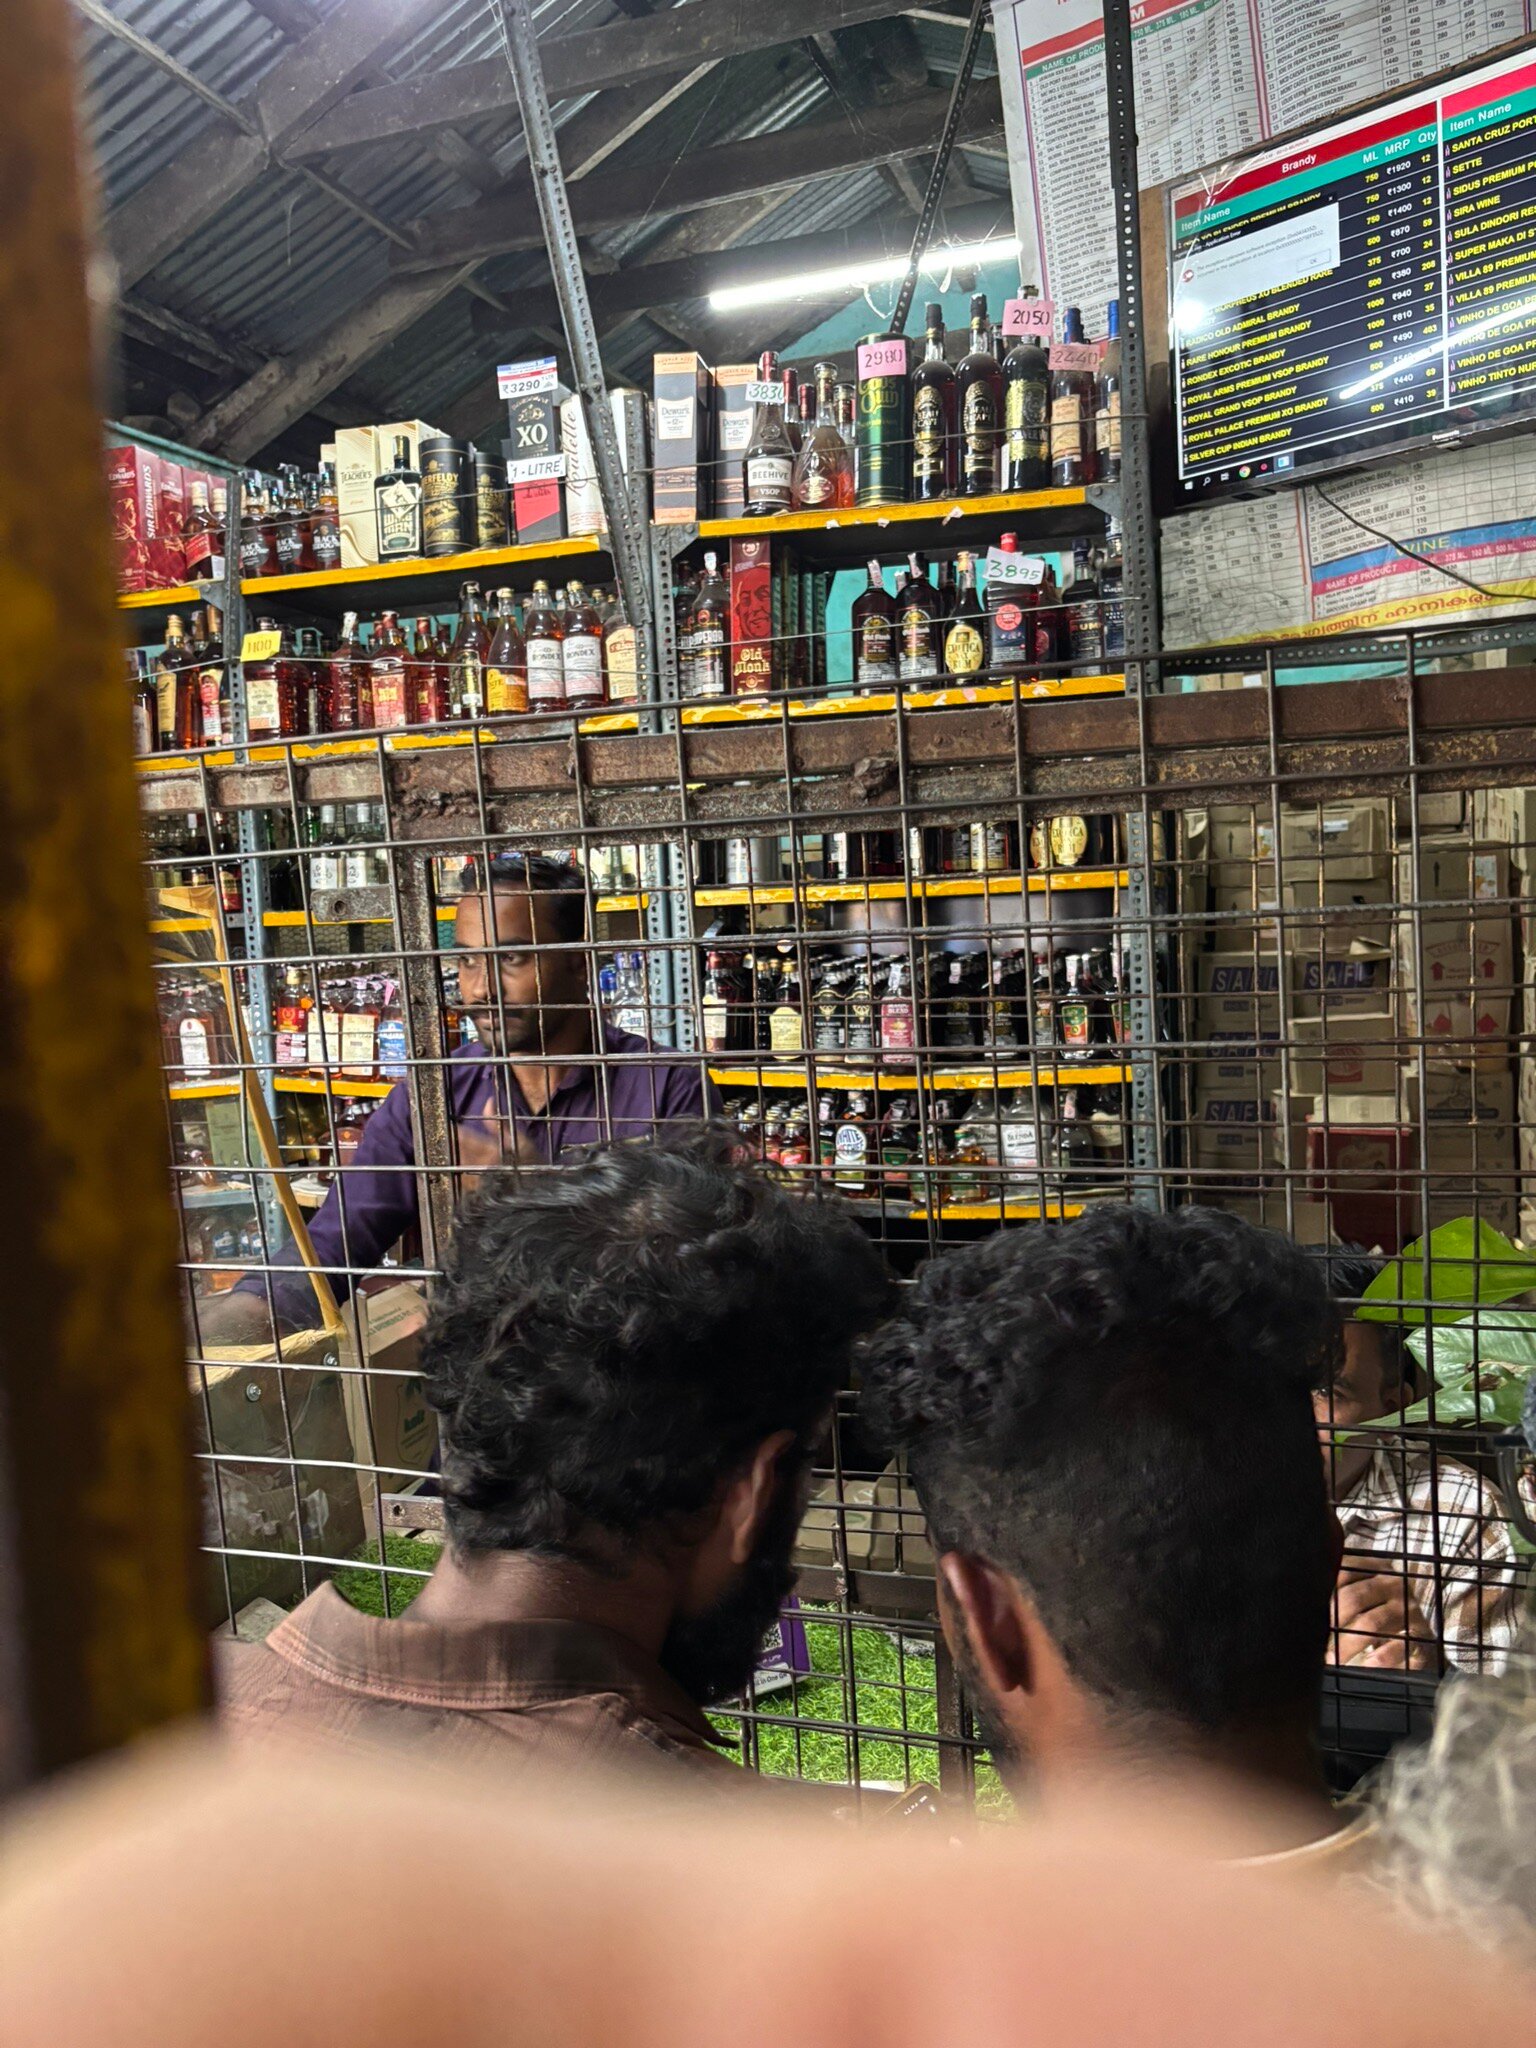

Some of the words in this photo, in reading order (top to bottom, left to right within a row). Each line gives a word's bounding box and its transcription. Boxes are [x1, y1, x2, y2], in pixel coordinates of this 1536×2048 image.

[1318, 13, 1341, 25] BRANDY
[1317, 34, 1339, 46] BRANDY
[1042, 58, 1064, 73] NAME
[1066, 54, 1077, 64] OF
[1347, 55, 1367, 68] BRANDY
[1450, 116, 1475, 132] Item
[1478, 102, 1512, 122] Name
[1452, 135, 1483, 153] SANTA
[1484, 125, 1511, 141] CRUZ
[1281, 154, 1317, 173] Brandy
[1365, 172, 1379, 183] 750
[1386, 160, 1411, 175] ₹1920
[1421, 153, 1431, 163] 12
[1452, 156, 1483, 174] SETTE
[1181, 217, 1201, 232] Item
[1203, 207, 1231, 224] Name
[1362, 150, 1379, 164] ML
[1384, 138, 1411, 156] MRP
[1418, 130, 1437, 144] Qty
[1366, 193, 1380, 204] 750
[1387, 181, 1412, 196] ₹1300
[1421, 175, 1432, 185] 12
[1452, 179, 1481, 196] SIDUS
[1482, 163, 1526, 186] PREMIUM
[1366, 214, 1381, 226] 750
[1388, 203, 1412, 217] ₹1400
[1422, 196, 1433, 206] 12
[1453, 202, 1475, 218] SIRA
[1476, 194, 1501, 210] WINE
[1366, 235, 1381, 246] 500
[1390, 225, 1411, 238] ₹870
[1422, 218, 1433, 228] 59
[1454, 224, 1479, 239] SULA
[1480, 210, 1519, 231] DINDORI
[1367, 256, 1382, 267] 375
[1391, 246, 1411, 259] ₹700
[1422, 238, 1434, 249] 24
[1454, 244, 1486, 261] SUPER
[1487, 234, 1515, 251] MAKA
[1516, 231, 1527, 242] DI
[1368, 277, 1382, 288] 500
[1391, 267, 1411, 280] ₹380
[1455, 266, 1482, 282] VILLA
[1482, 263, 1494, 274] 89
[1456, 288, 1482, 304] VILLA
[1483, 284, 1495, 296] 89
[1012, 308, 1050, 325] 2050
[1215, 326, 1231, 337] OLD
[1232, 315, 1266, 331] ADMIRAL
[1266, 303, 1300, 320] BRANDY
[1367, 298, 1385, 309] 1000
[1392, 288, 1412, 301] ₹940
[1424, 281, 1435, 291] 27
[1456, 309, 1486, 325] VINHO
[1486, 305, 1500, 317] DE
[1501, 299, 1523, 311] GOA
[1186, 355, 1208, 366] RARE
[1208, 343, 1241, 360] HONOUR
[1241, 331, 1277, 349] PREMIUM
[1278, 320, 1312, 337] BRANDY
[1367, 318, 1385, 330] 1000
[1392, 309, 1412, 322] ₹810
[1424, 303, 1435, 313] 35
[1487, 326, 1500, 338] DE
[1502, 320, 1524, 333] GOA
[864, 348, 902, 368] 2980
[1187, 370, 1218, 386] RONDEX
[1219, 360, 1252, 376] EXCOTIC
[1253, 349, 1287, 366] BRANDY
[1369, 340, 1383, 351] 500
[1392, 330, 1413, 343] ₹490
[1457, 352, 1486, 368] VINHO
[1487, 348, 1501, 360] DE
[1502, 342, 1525, 356] GOA
[502, 379, 540, 394] ₹3290
[1187, 391, 1213, 405] ROYAL
[1213, 383, 1235, 397] ARMS
[1235, 373, 1272, 390] PREMIUM
[1272, 366, 1294, 379] VSOP
[1295, 356, 1329, 373] BRANDY
[1457, 374, 1487, 390] VINHO
[1488, 366, 1517, 382] TINTO
[1188, 411, 1213, 424] ROYAL
[1213, 402, 1241, 416] GRAND
[1241, 396, 1263, 408] VSOP
[1264, 385, 1297, 402] BRANDY
[1393, 373, 1414, 385] ₹440
[661, 406, 690, 416] Dewar's
[722, 417, 750, 427] Dewar's
[1188, 429, 1214, 443] ROYAL
[1214, 421, 1244, 435] PALACE
[1245, 411, 1281, 427] PREMIUM
[1281, 406, 1294, 417] XO
[1294, 397, 1329, 414] BRANDY
[1370, 403, 1385, 413] 500
[1394, 394, 1414, 406] ₹410
[1426, 388, 1437, 399] 39
[516, 423, 548, 448] XO
[1189, 448, 1215, 462] SILVER
[1216, 443, 1233, 455] CUP
[1232, 436, 1259, 450] INDIAN
[1259, 427, 1293, 443] BRANDY
[340, 470, 373, 484] TEACHER'S
[528, 462, 561, 476] LITRE
[751, 471, 789, 480] BEEHIVE
[142, 464, 155, 519] EDWARDS
[147, 519, 157, 539] SIR
[1396, 537, 1450, 556] WINE
[989, 559, 1040, 580] 3895
[1325, 579, 1344, 590] NAME
[1346, 575, 1358, 585] OF
[1360, 565, 1397, 581] PRODUCT
[532, 653, 562, 661] RONDEX
[565, 649, 596, 658] RONDEX
[740, 648, 762, 662] Old
[733, 660, 771, 676] Monk
